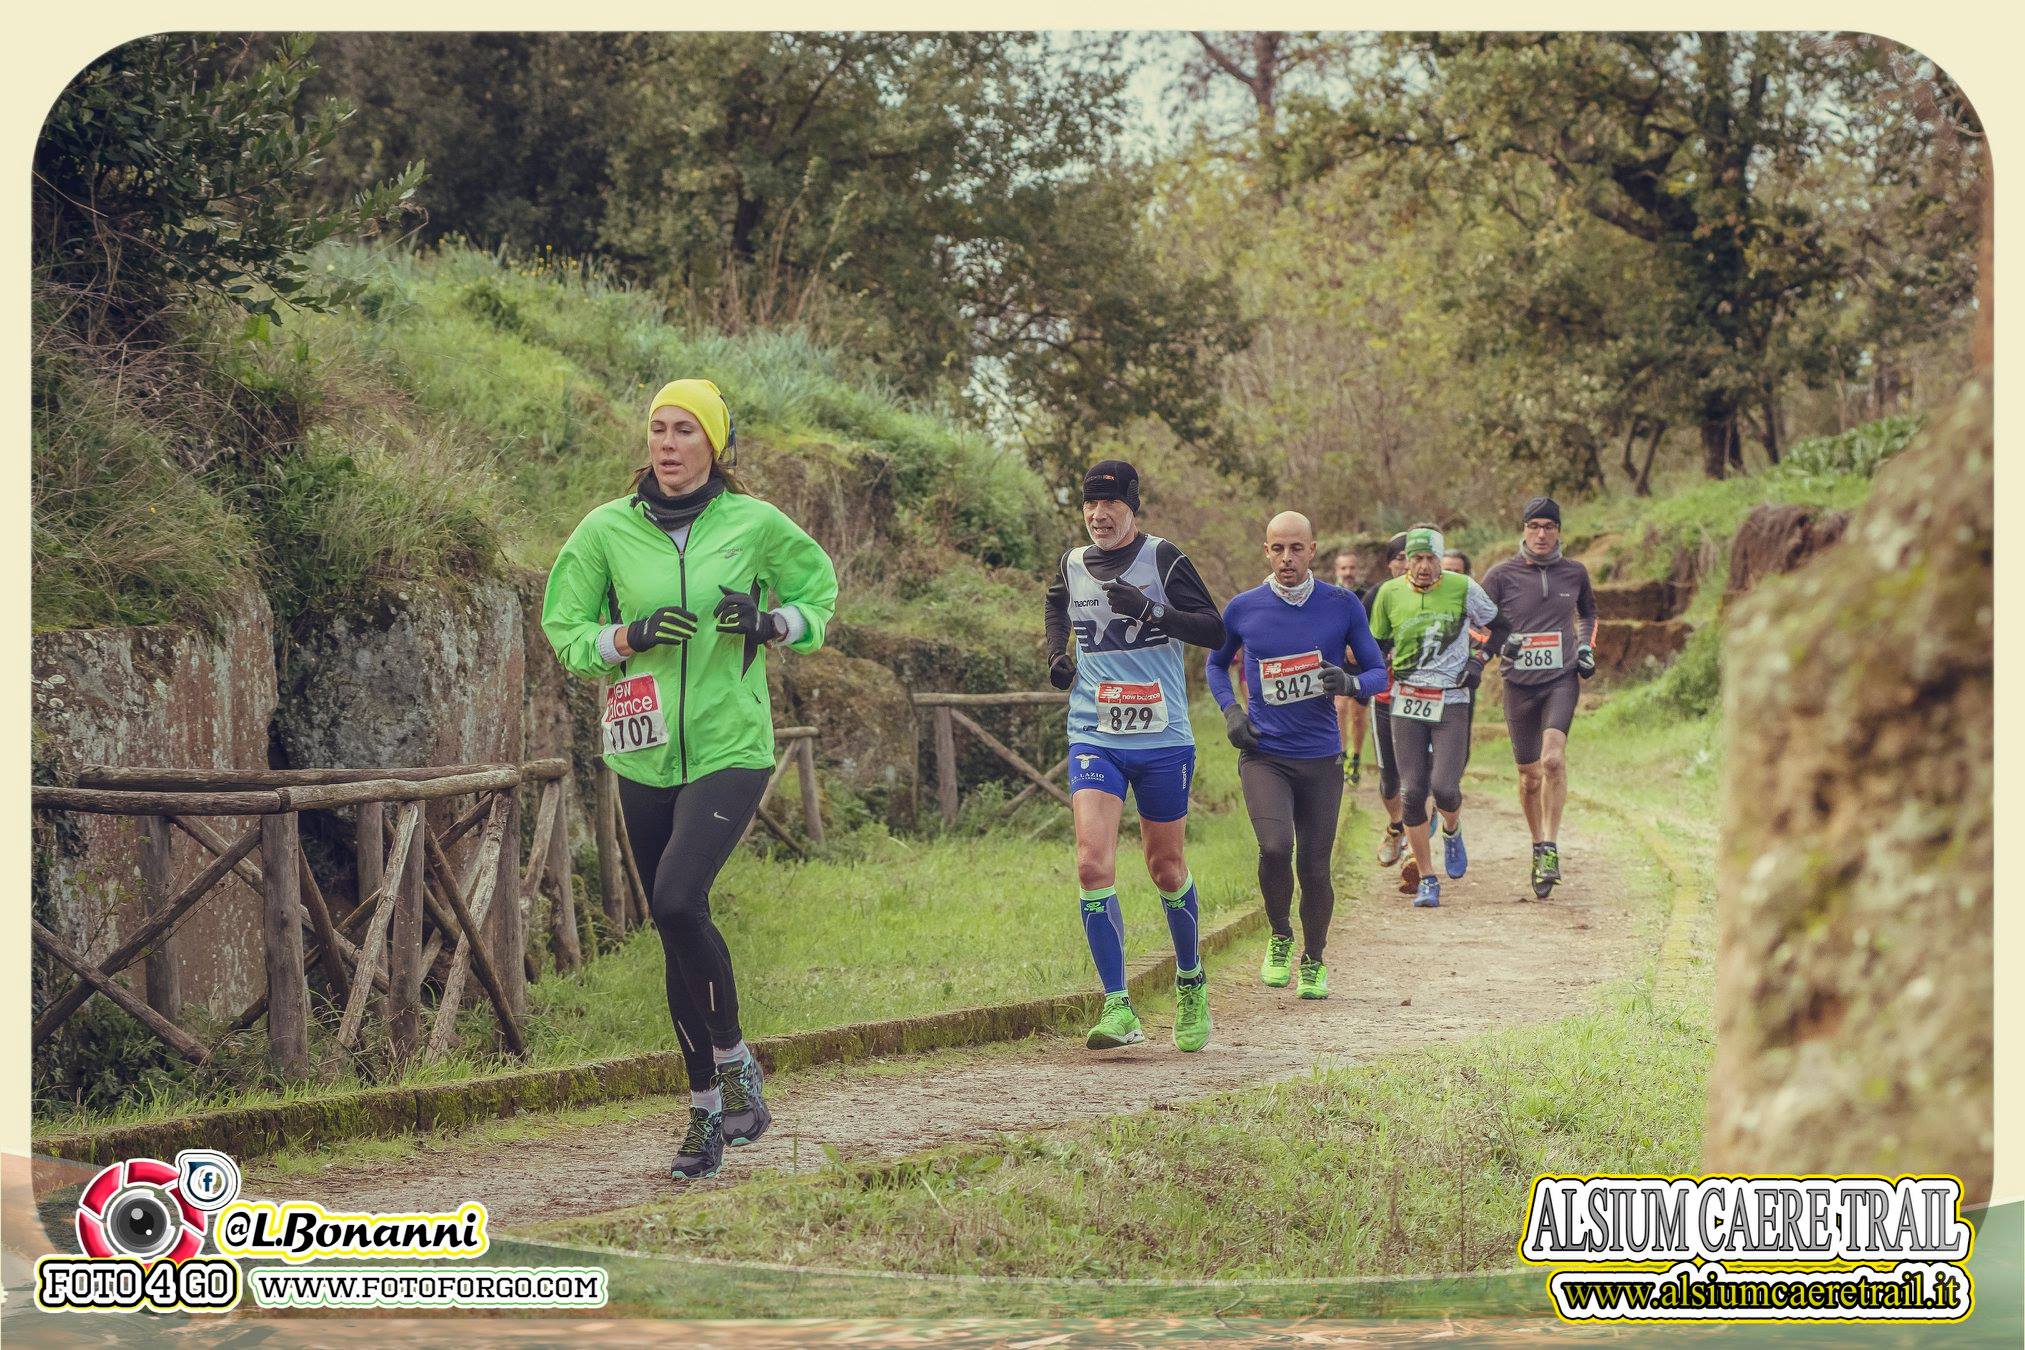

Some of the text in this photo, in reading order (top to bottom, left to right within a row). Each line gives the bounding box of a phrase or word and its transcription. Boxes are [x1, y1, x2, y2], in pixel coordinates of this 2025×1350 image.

[1073, 599, 1099, 608] macron
[1295, 662, 1319, 670] balance
[1525, 649, 1552, 667] 868
[1137, 692, 1160, 700] balance
[1275, 674, 1314, 701] 842
[1403, 699, 1431, 717] 826
[1110, 706, 1153, 731] 829
